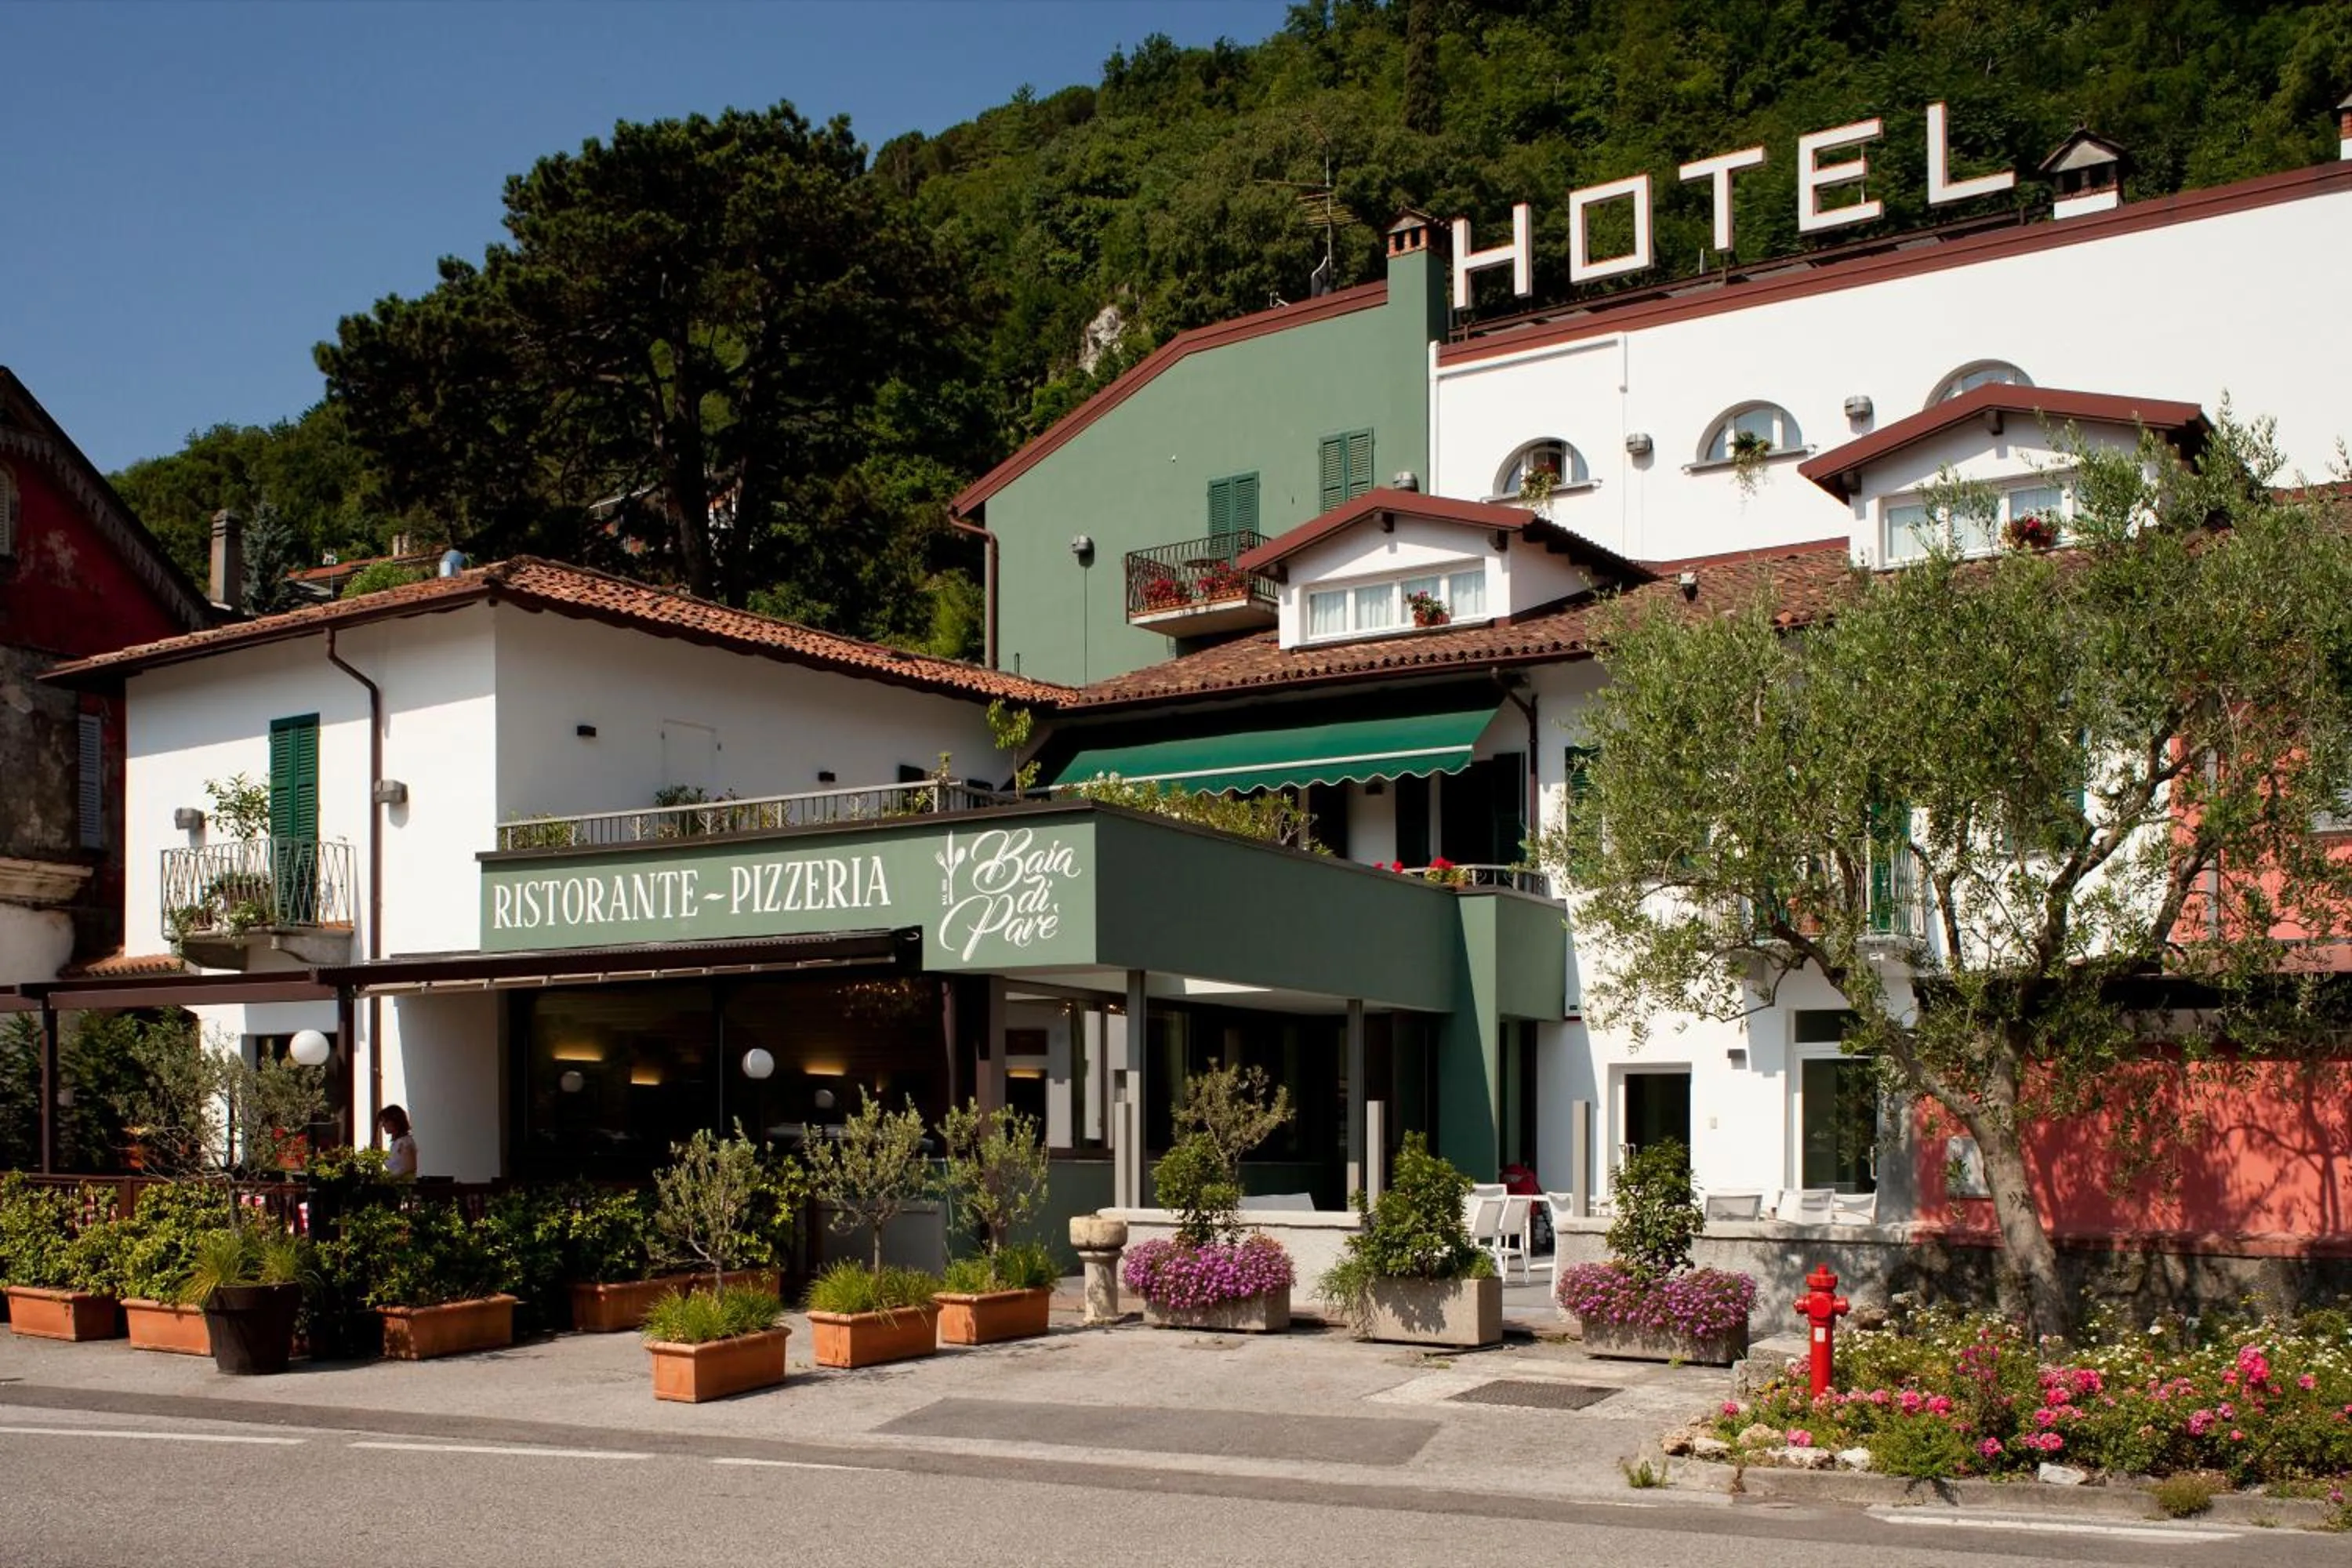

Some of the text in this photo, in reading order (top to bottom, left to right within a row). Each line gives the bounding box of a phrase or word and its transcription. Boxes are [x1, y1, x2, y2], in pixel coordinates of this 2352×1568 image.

[1452, 101, 2016, 310] HOTEL
[493, 869, 699, 929] RISTORANTE
[730, 855, 891, 914] PIZZERIA
[971, 828, 1081, 894] Baia
[1016, 875, 1053, 913] di
